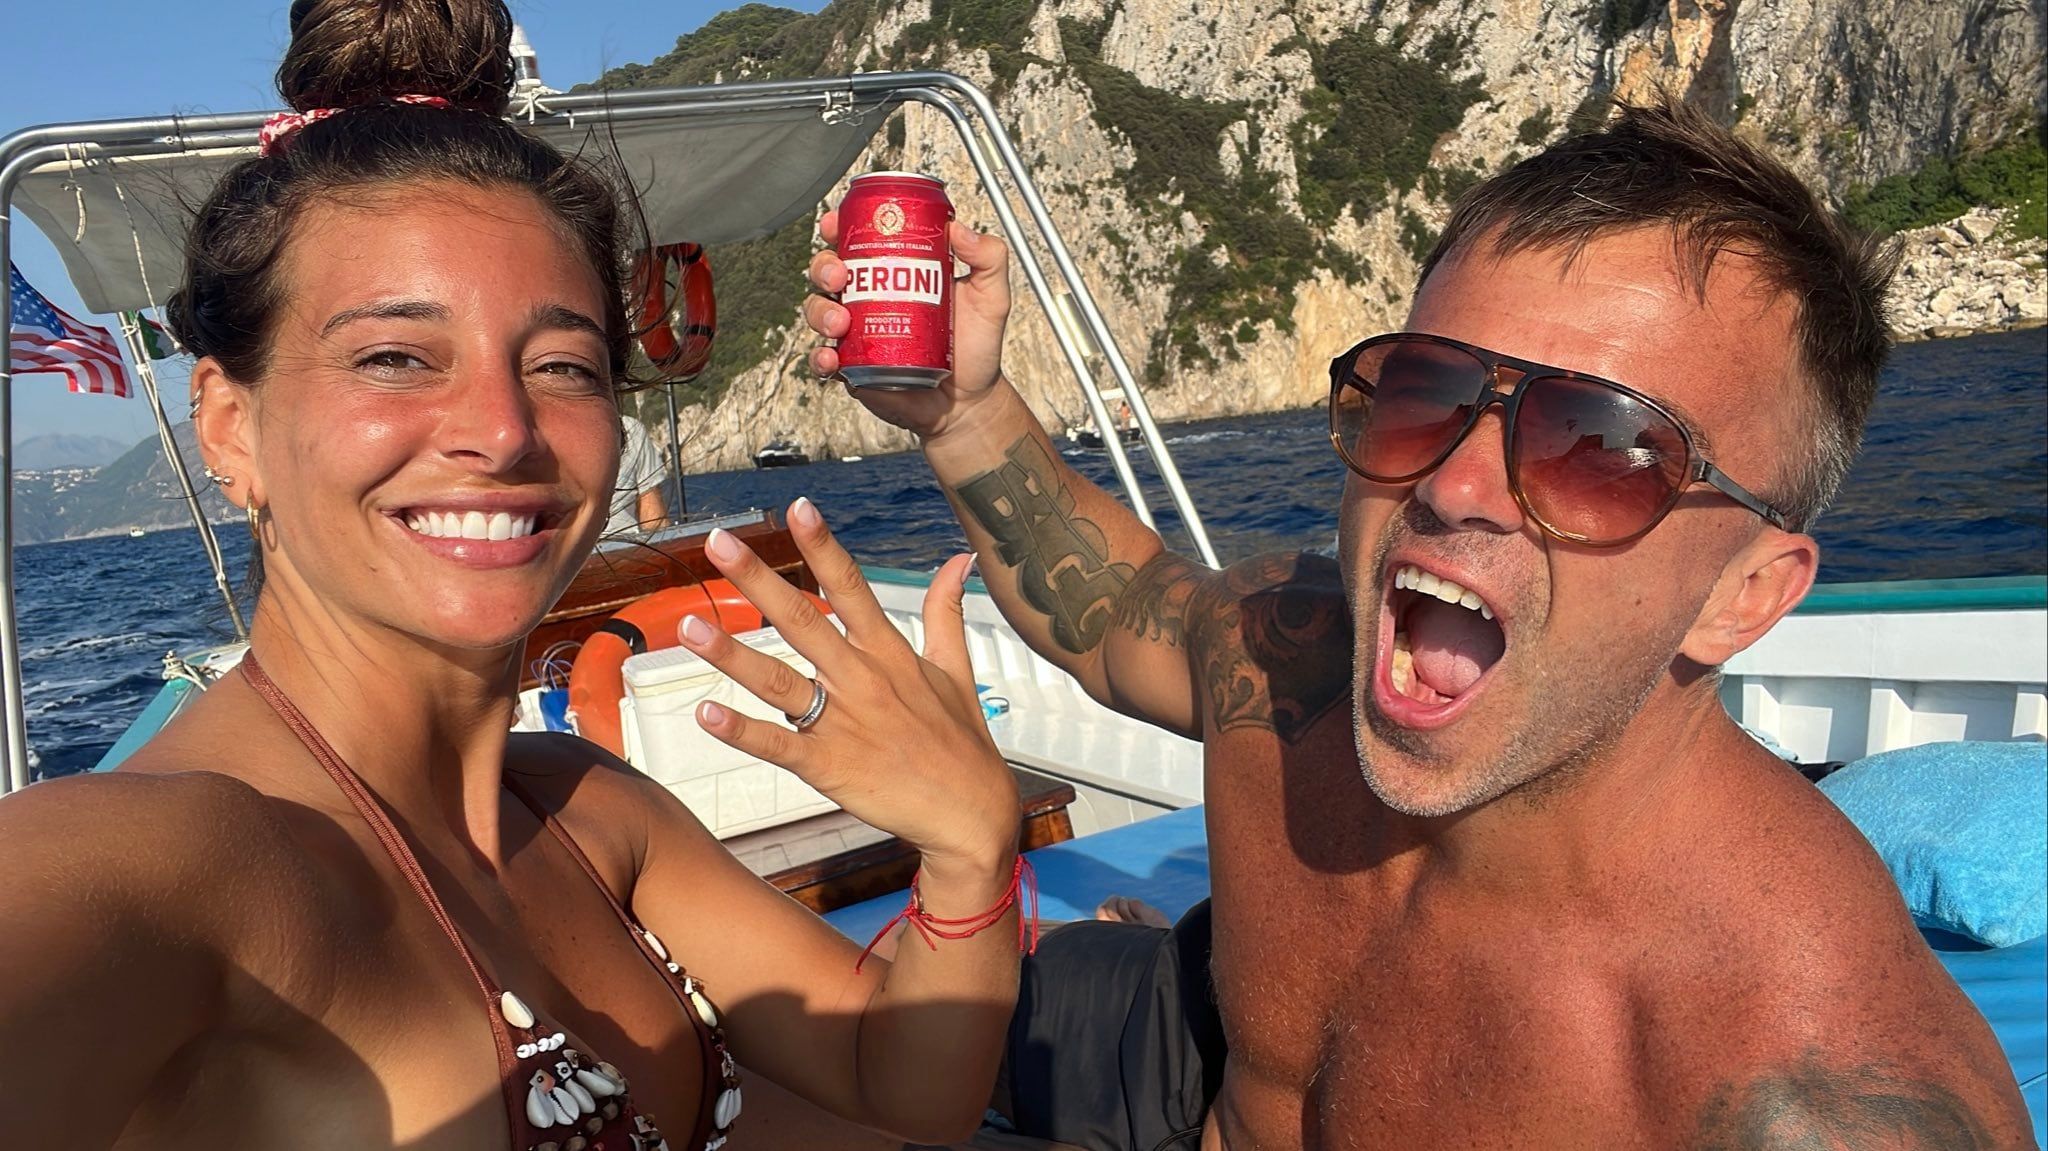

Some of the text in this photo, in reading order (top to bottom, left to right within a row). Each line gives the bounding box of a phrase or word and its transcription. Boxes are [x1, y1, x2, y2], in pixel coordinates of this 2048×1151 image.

[905, 242, 933, 251] ITALIANA
[842, 266, 939, 295] PERONI
[864, 316, 901, 324] PRODOTTA
[864, 324, 911, 334] ITALIA
